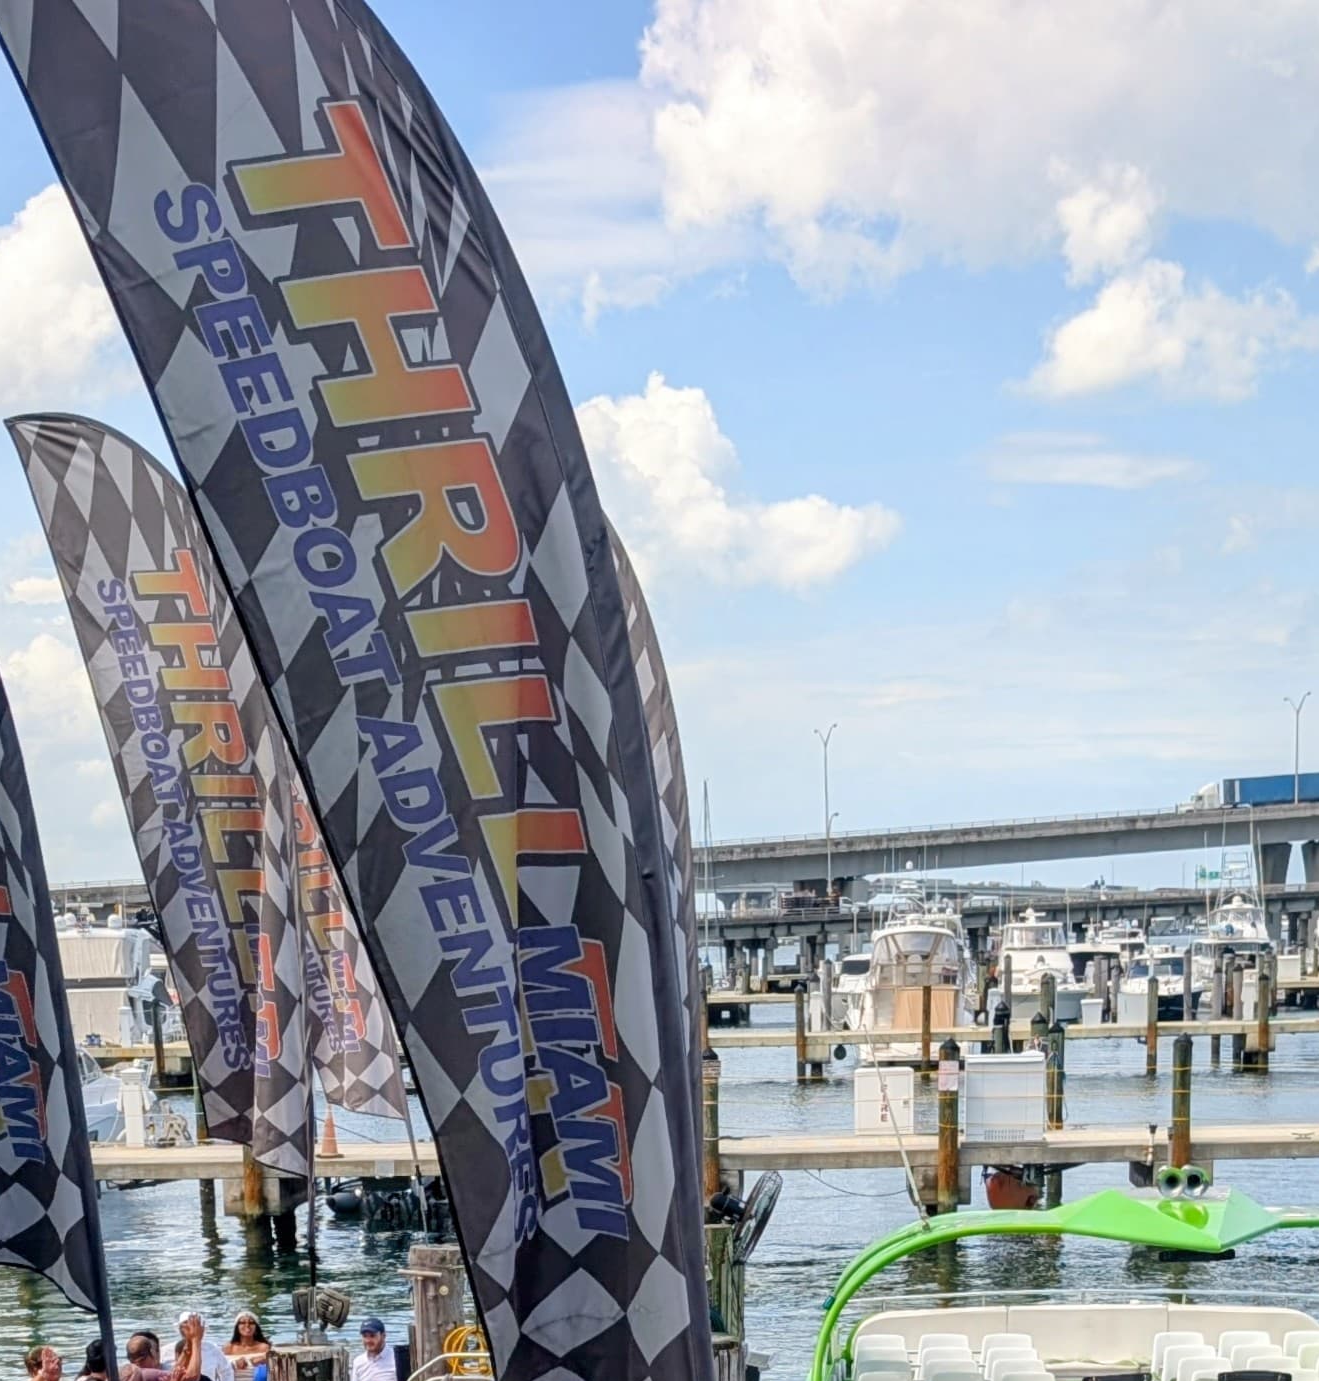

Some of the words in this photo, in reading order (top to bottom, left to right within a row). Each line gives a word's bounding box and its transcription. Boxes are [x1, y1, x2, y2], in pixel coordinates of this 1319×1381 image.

[96, 577, 188, 808] SPEEDBOAT
[162, 817, 252, 1075] ADVENTURES
[154, 181, 401, 694] SPEEDBOAT
[355, 715, 539, 1245] ADVENTURES
[232, 100, 632, 1206] THRILLER
[518, 923, 630, 1241] MIAMI
